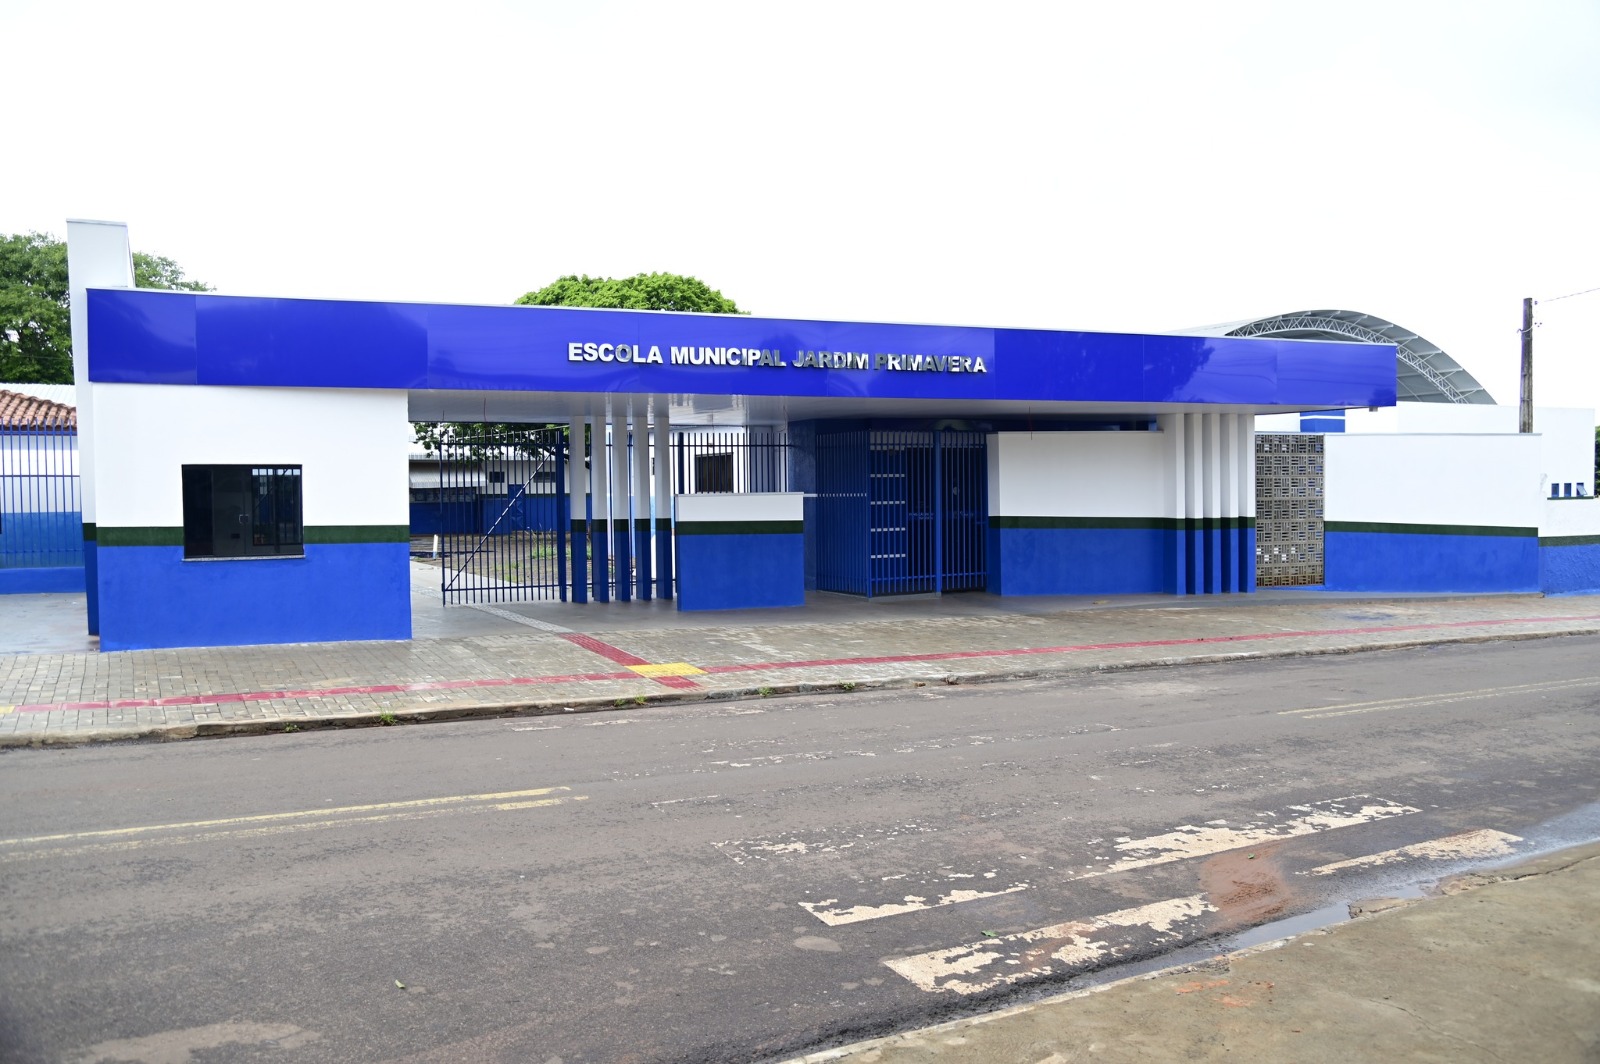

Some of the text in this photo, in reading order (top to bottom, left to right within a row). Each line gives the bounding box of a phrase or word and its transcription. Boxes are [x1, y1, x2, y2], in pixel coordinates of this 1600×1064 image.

[568, 342, 988, 373] ESCOLA MUNICIPAL JARDIM PRIMAVERA
